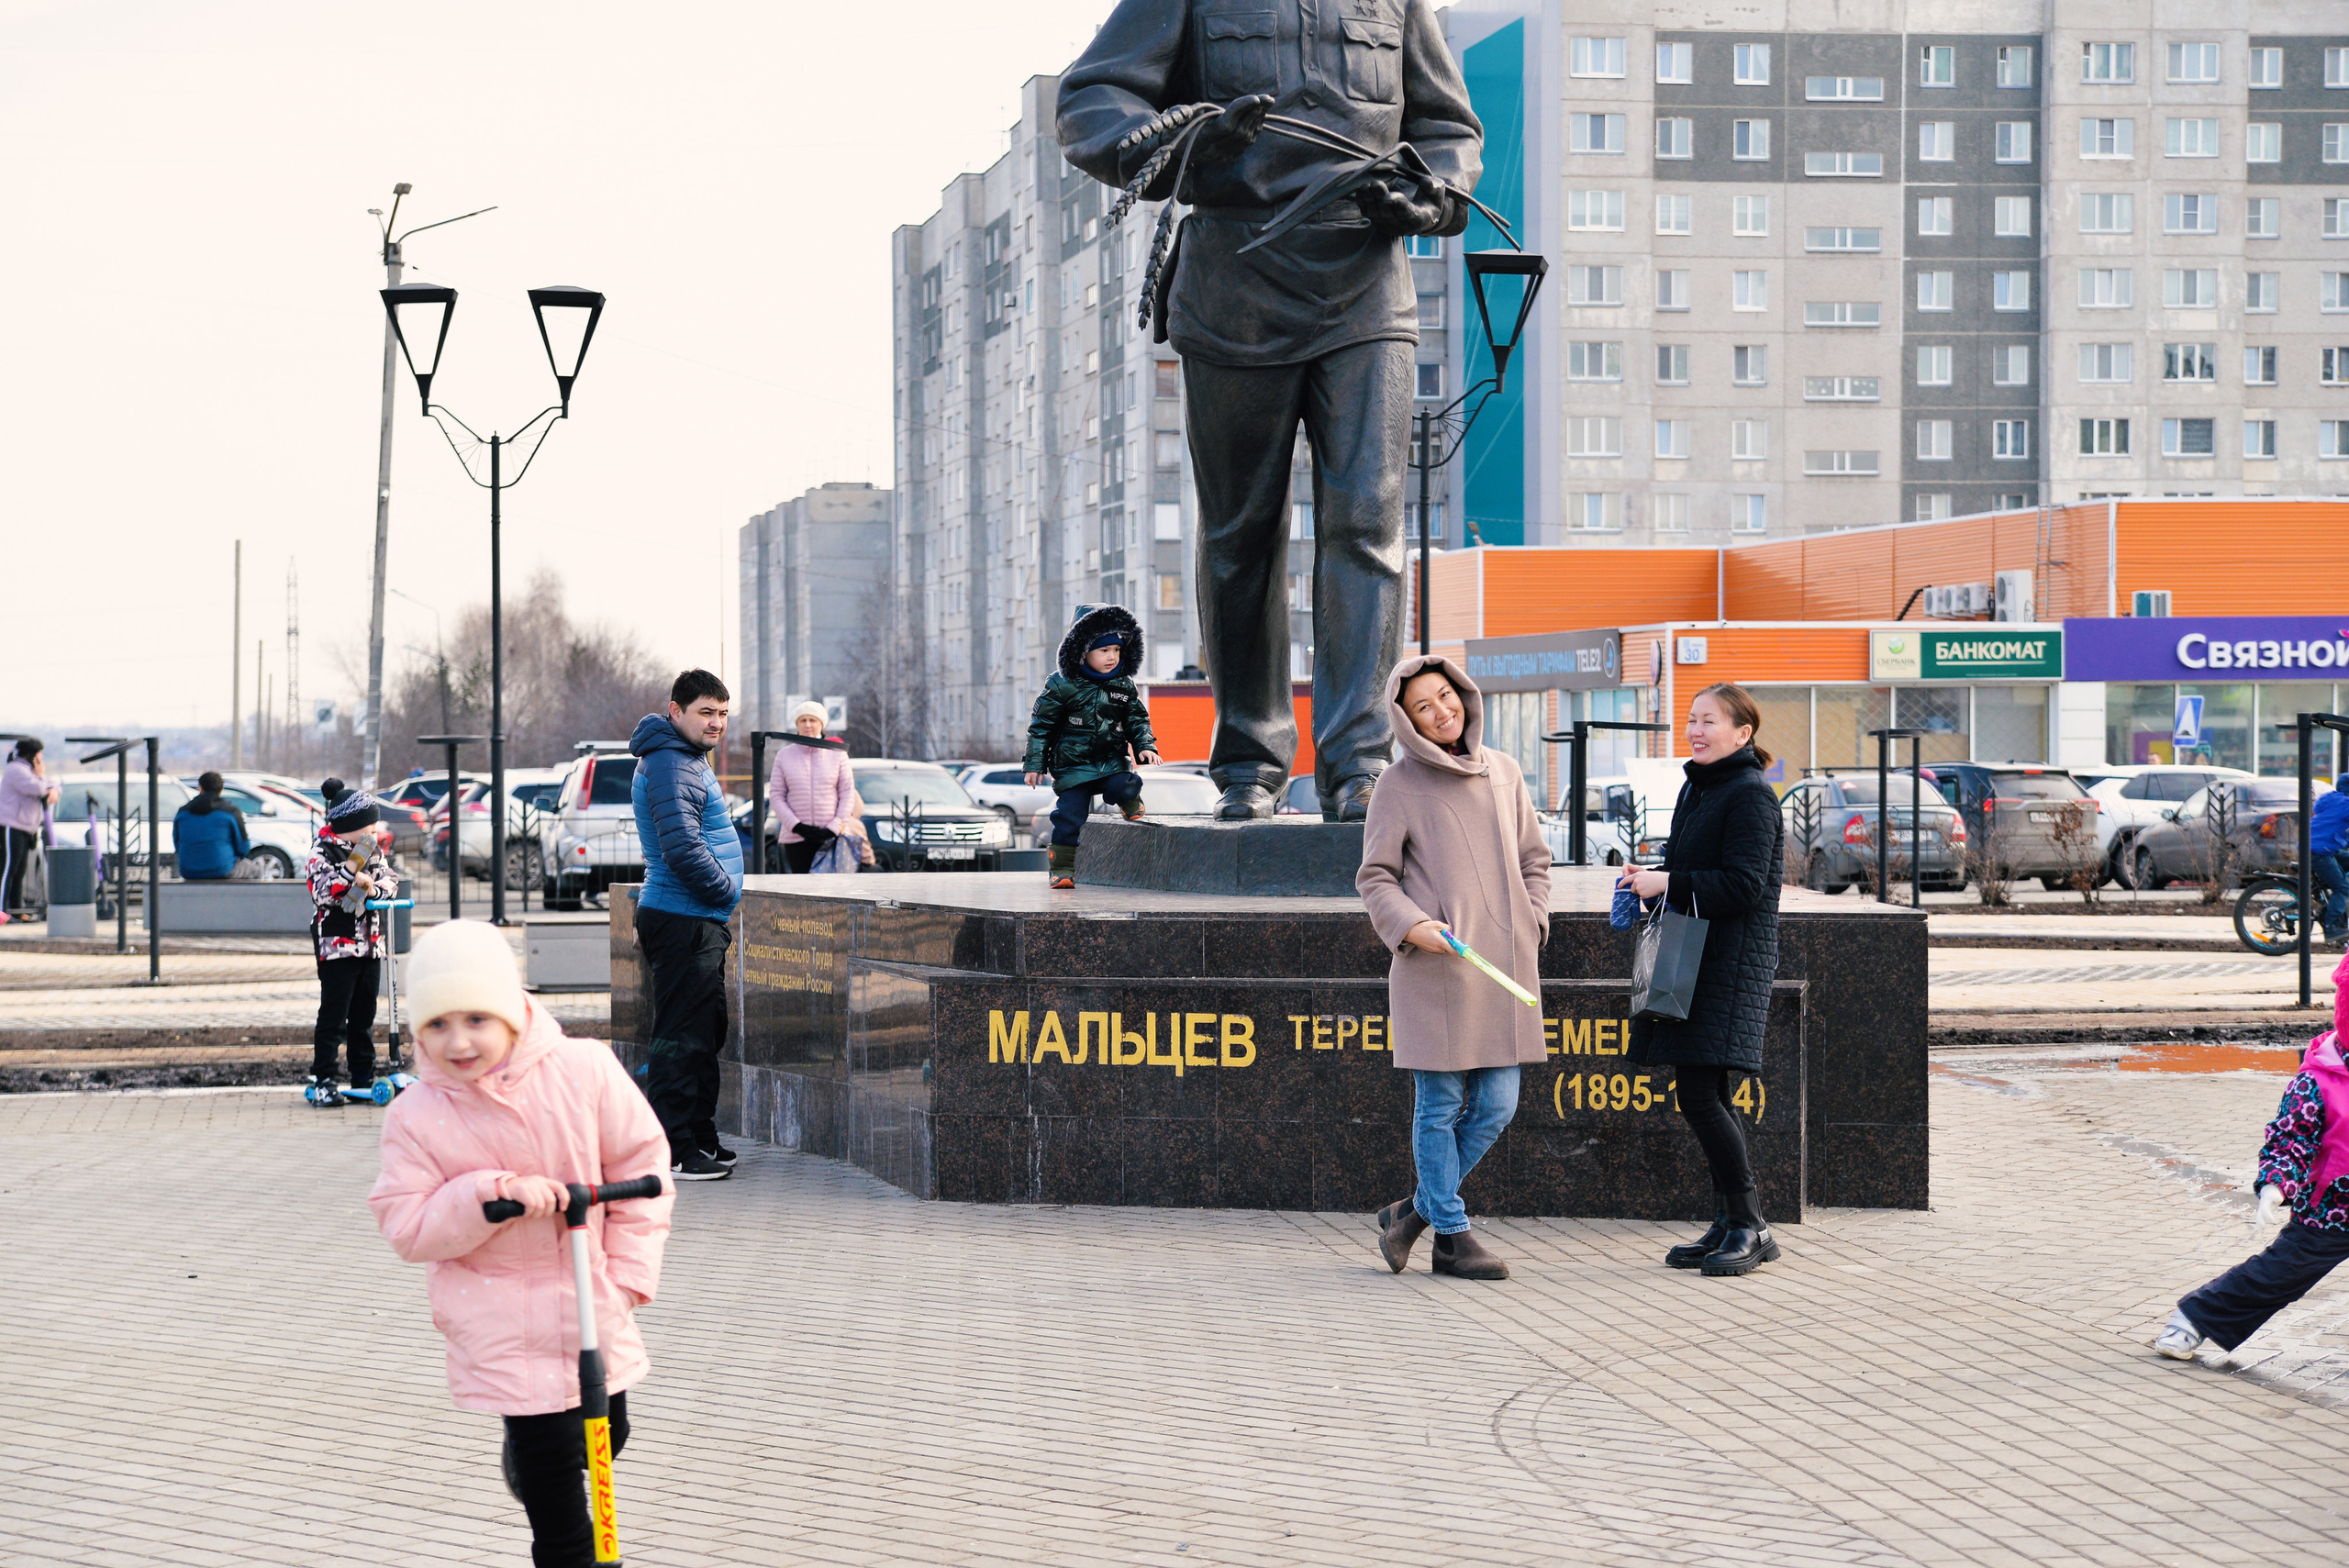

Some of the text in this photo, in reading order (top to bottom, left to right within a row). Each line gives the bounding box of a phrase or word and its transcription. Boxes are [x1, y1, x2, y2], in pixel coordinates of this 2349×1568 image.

[1575, 647, 1602, 673] TELE2
[1684, 648, 1700, 662] 30
[1935, 640, 2047, 660] БАНКОМАТ
[811, 946, 833, 970] Труда
[806, 973, 833, 995] России
[988, 1009, 1631, 1077] МАЛЬЦЕВ ТЕРЕ ЕМЕ
